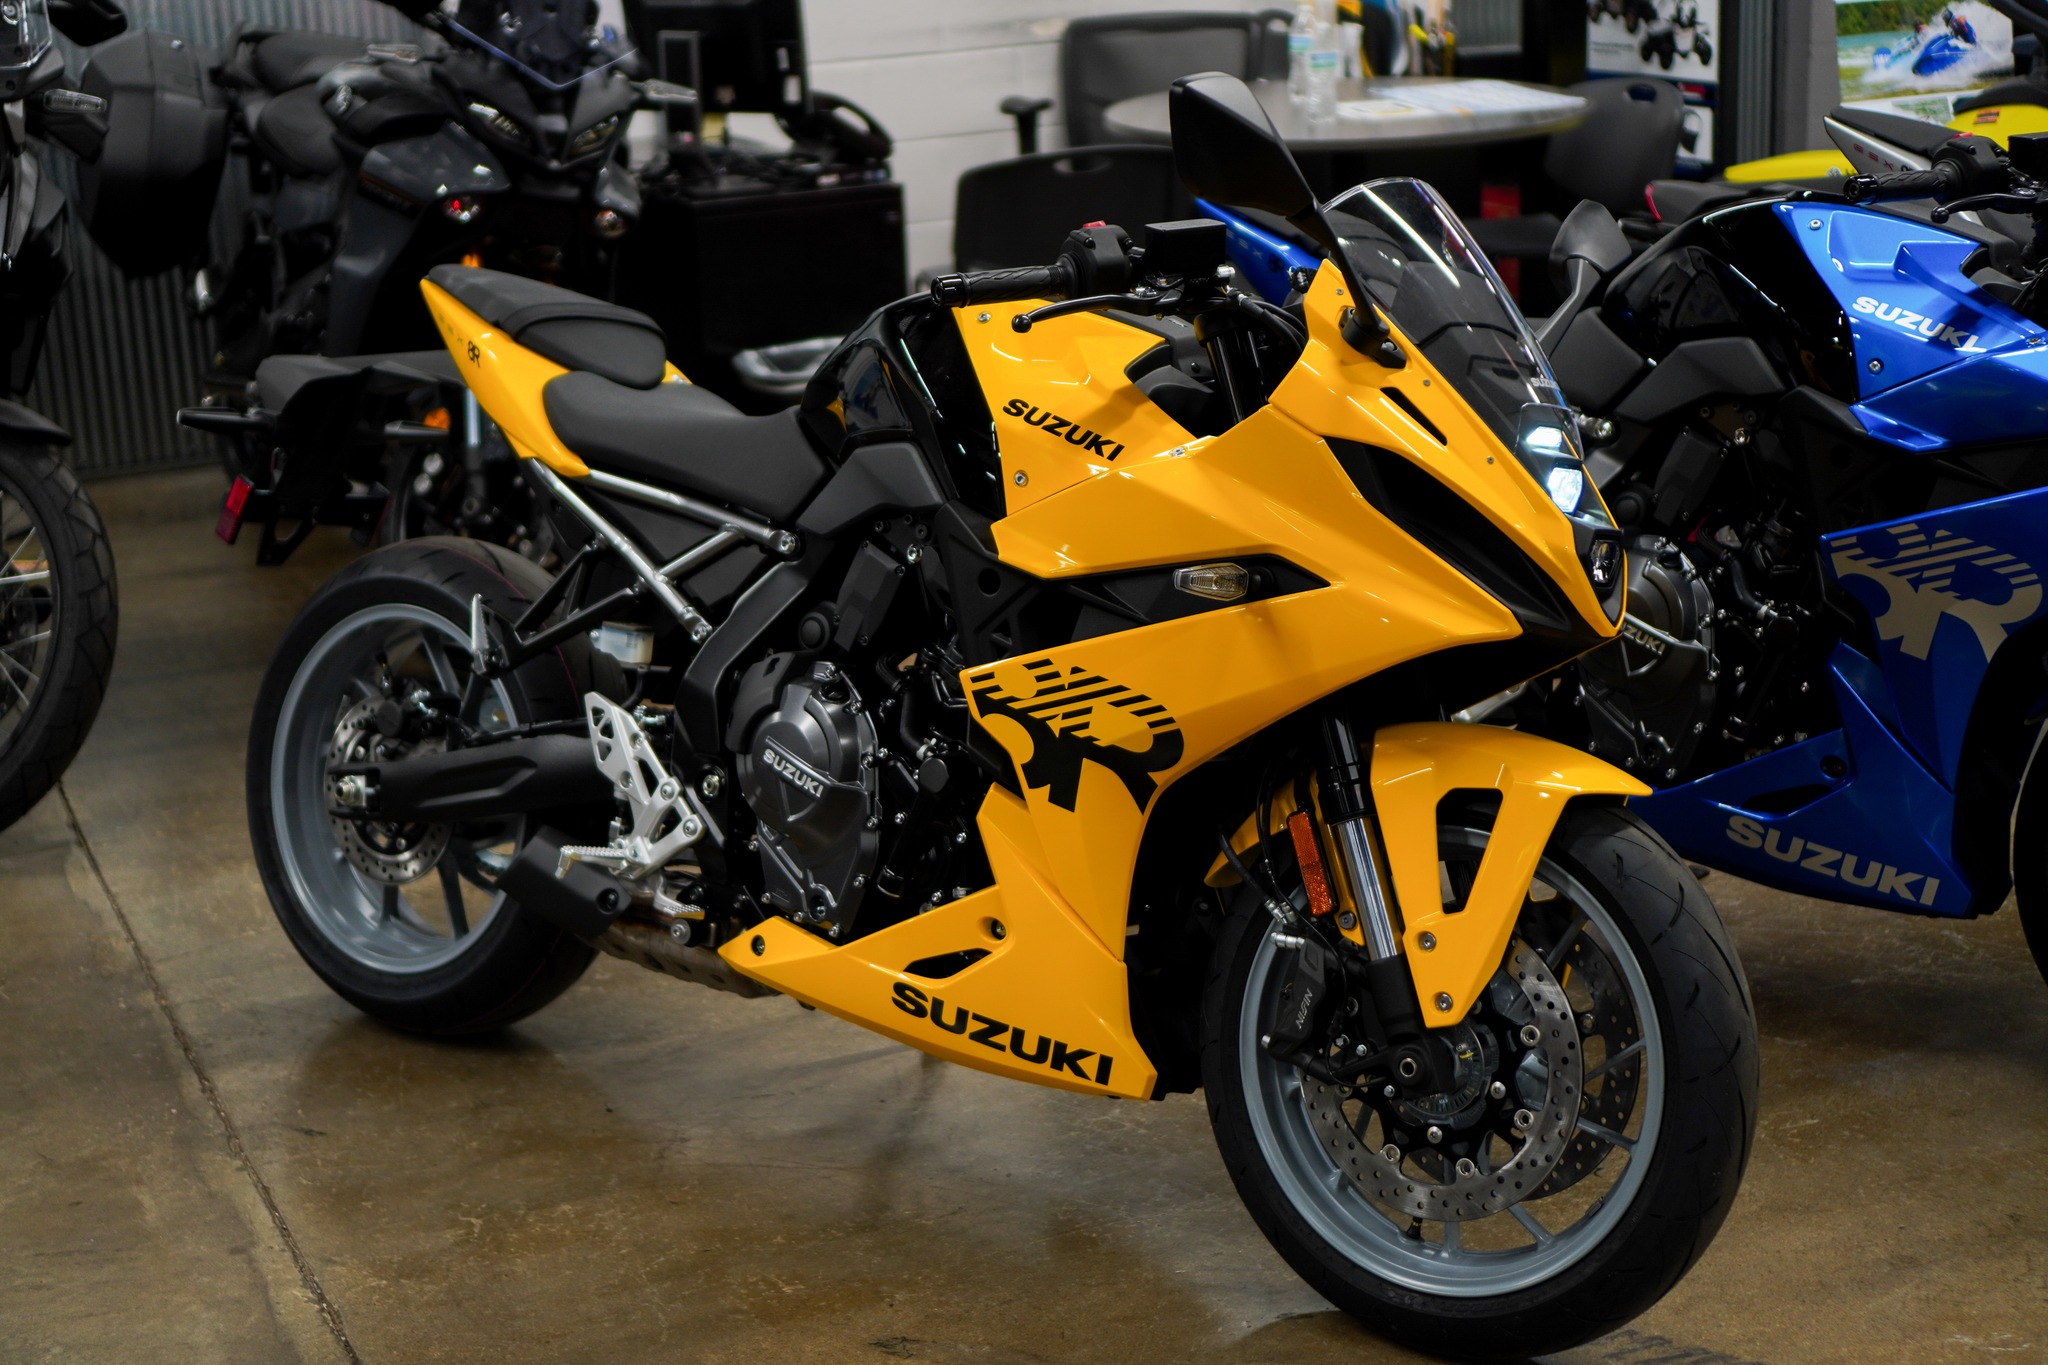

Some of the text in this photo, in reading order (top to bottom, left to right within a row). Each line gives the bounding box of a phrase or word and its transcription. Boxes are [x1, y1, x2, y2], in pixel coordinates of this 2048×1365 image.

[1852, 296, 1980, 350] SUZUKI
[1002, 398, 1126, 462] SUZUKI
[763, 748, 824, 798] SUZUKI
[1725, 815, 1940, 906] SUZUKI
[891, 981, 1114, 1086] SUZUKI
